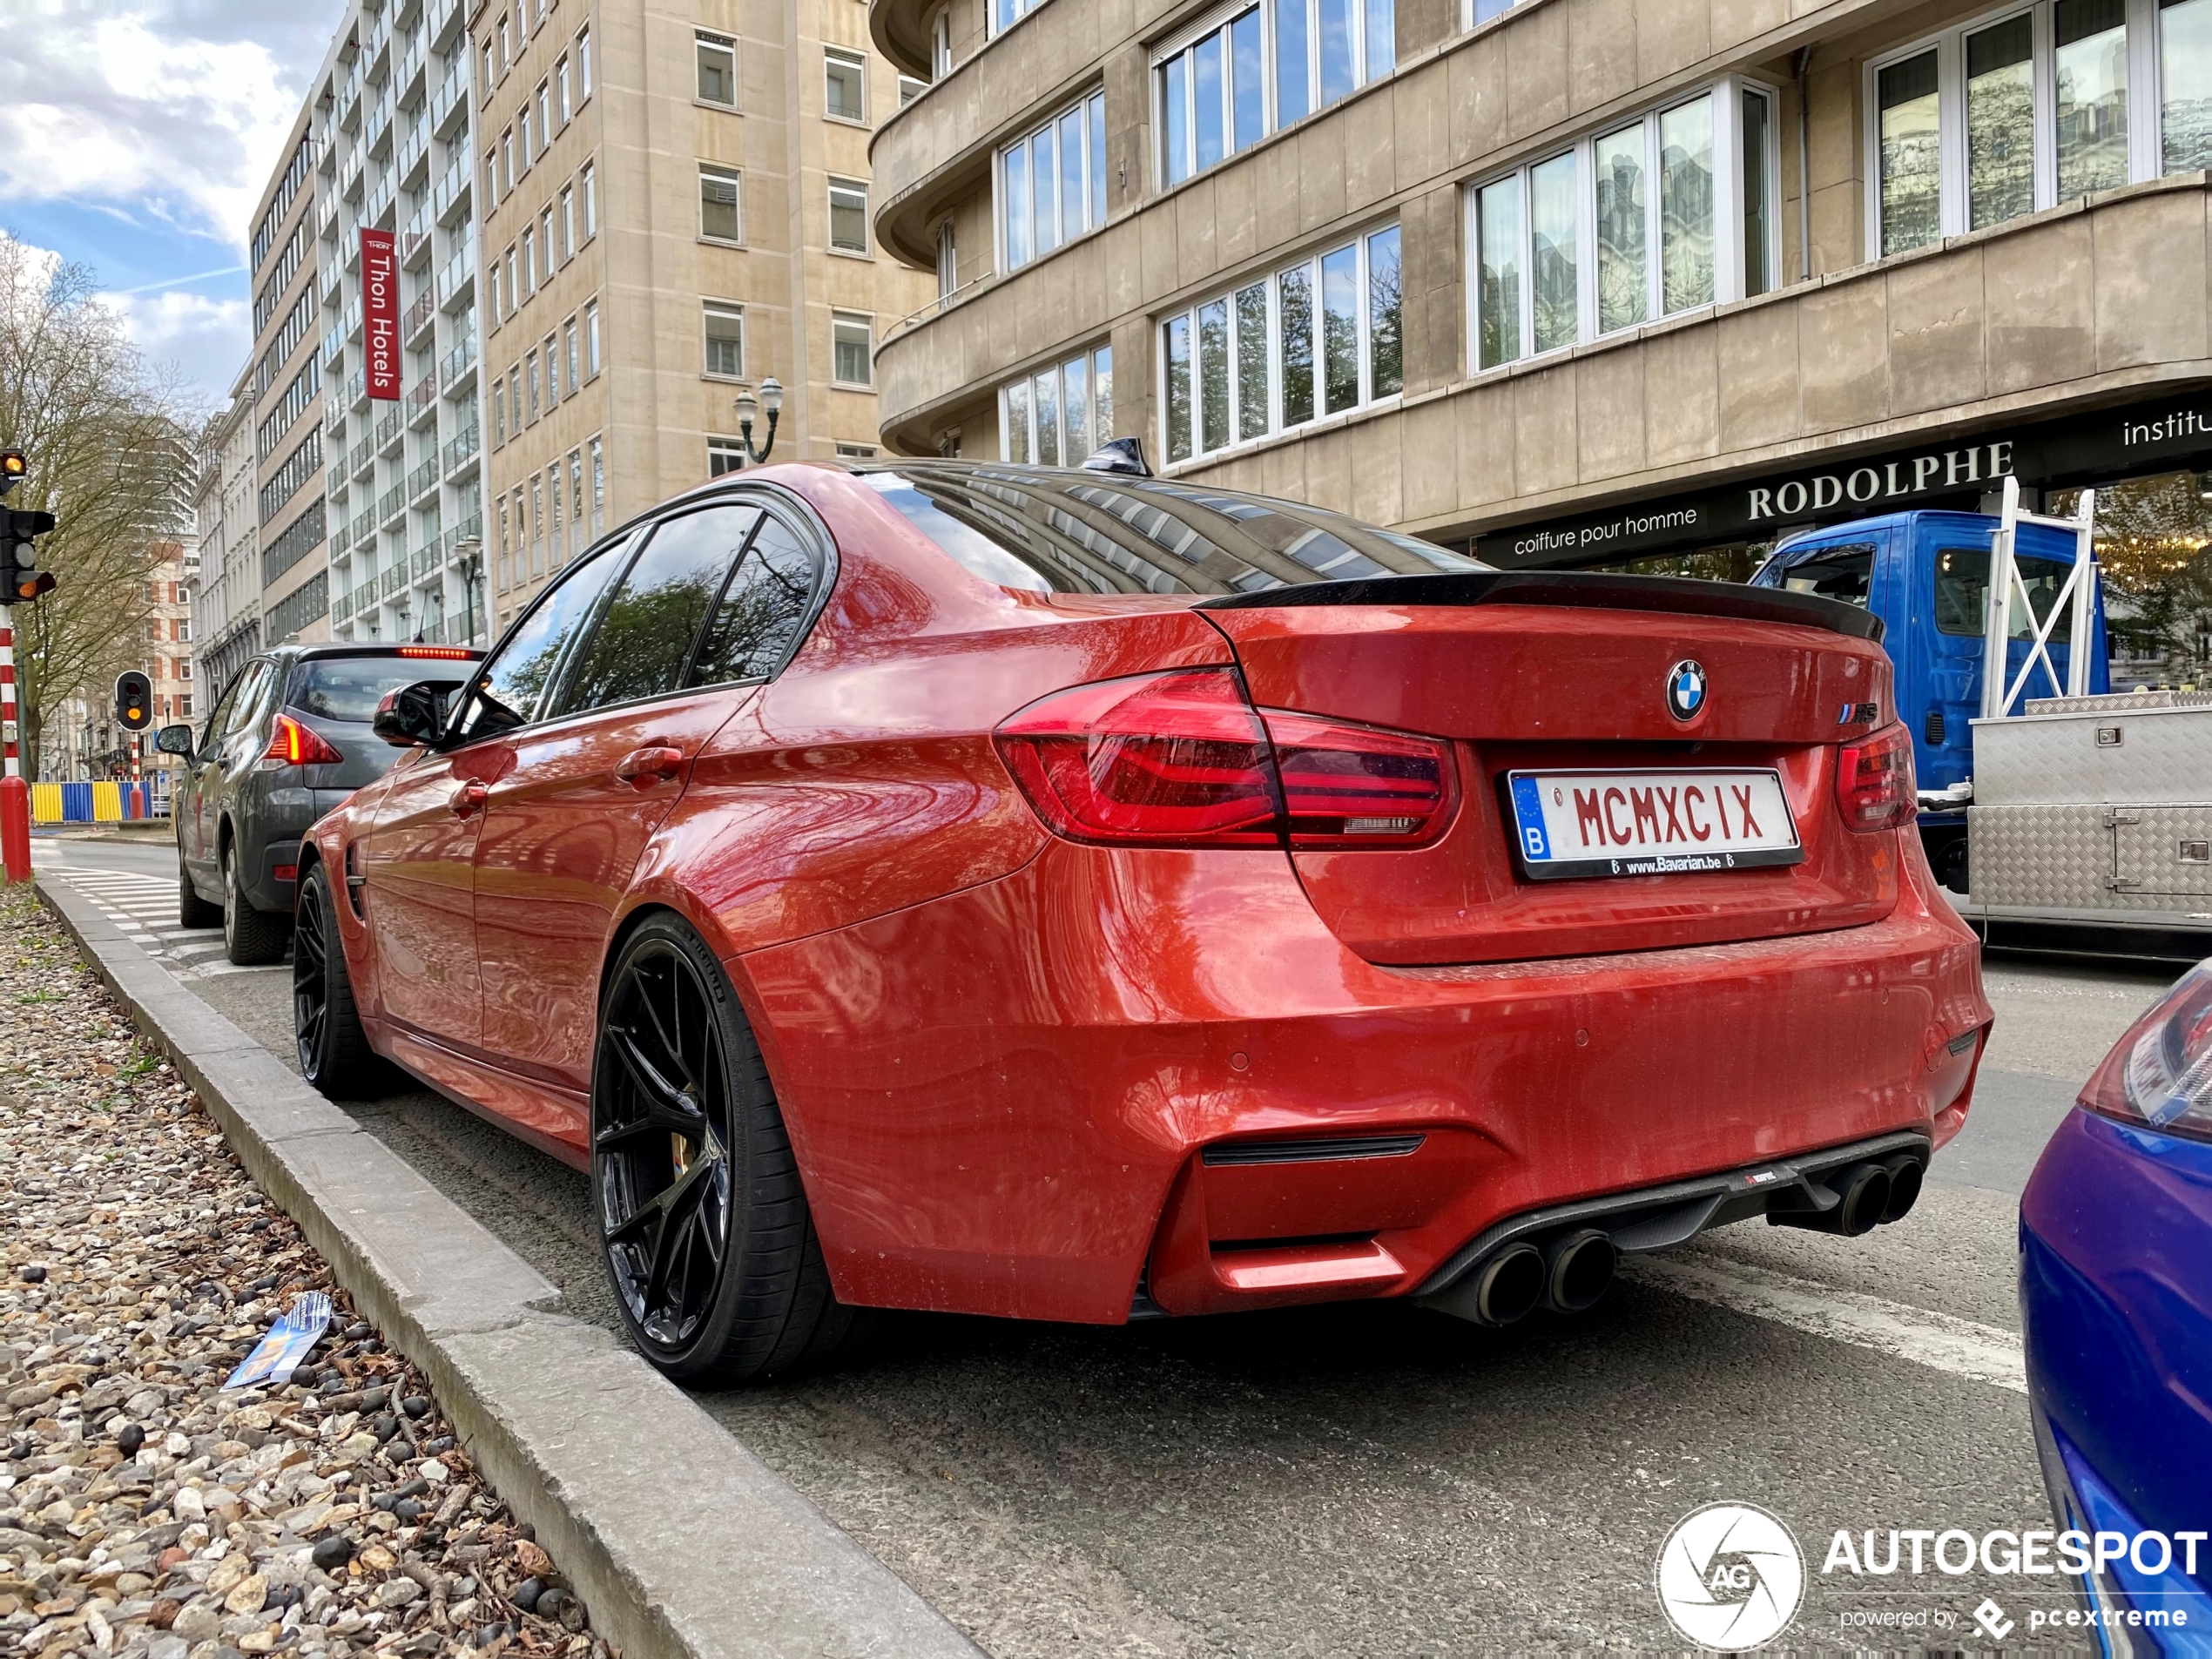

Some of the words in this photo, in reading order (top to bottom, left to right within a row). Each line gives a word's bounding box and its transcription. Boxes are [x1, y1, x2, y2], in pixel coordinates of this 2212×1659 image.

[366, 240, 393, 250] THON
[370, 255, 390, 309] Thon
[372, 318, 394, 388] Hotels
[1747, 441, 2014, 521] RODOLPHE
[1514, 531, 1576, 555] coiffure
[1581, 523, 1621, 548] pour
[1625, 509, 1697, 535] homme
[1674, 662, 1706, 682] BMW
[1526, 827, 1545, 855] B
[1573, 785, 1764, 847] MCMXCIX
[1626, 854, 1722, 874] www.Bavarian.be
[691, 937, 724, 999] MICHELIN
